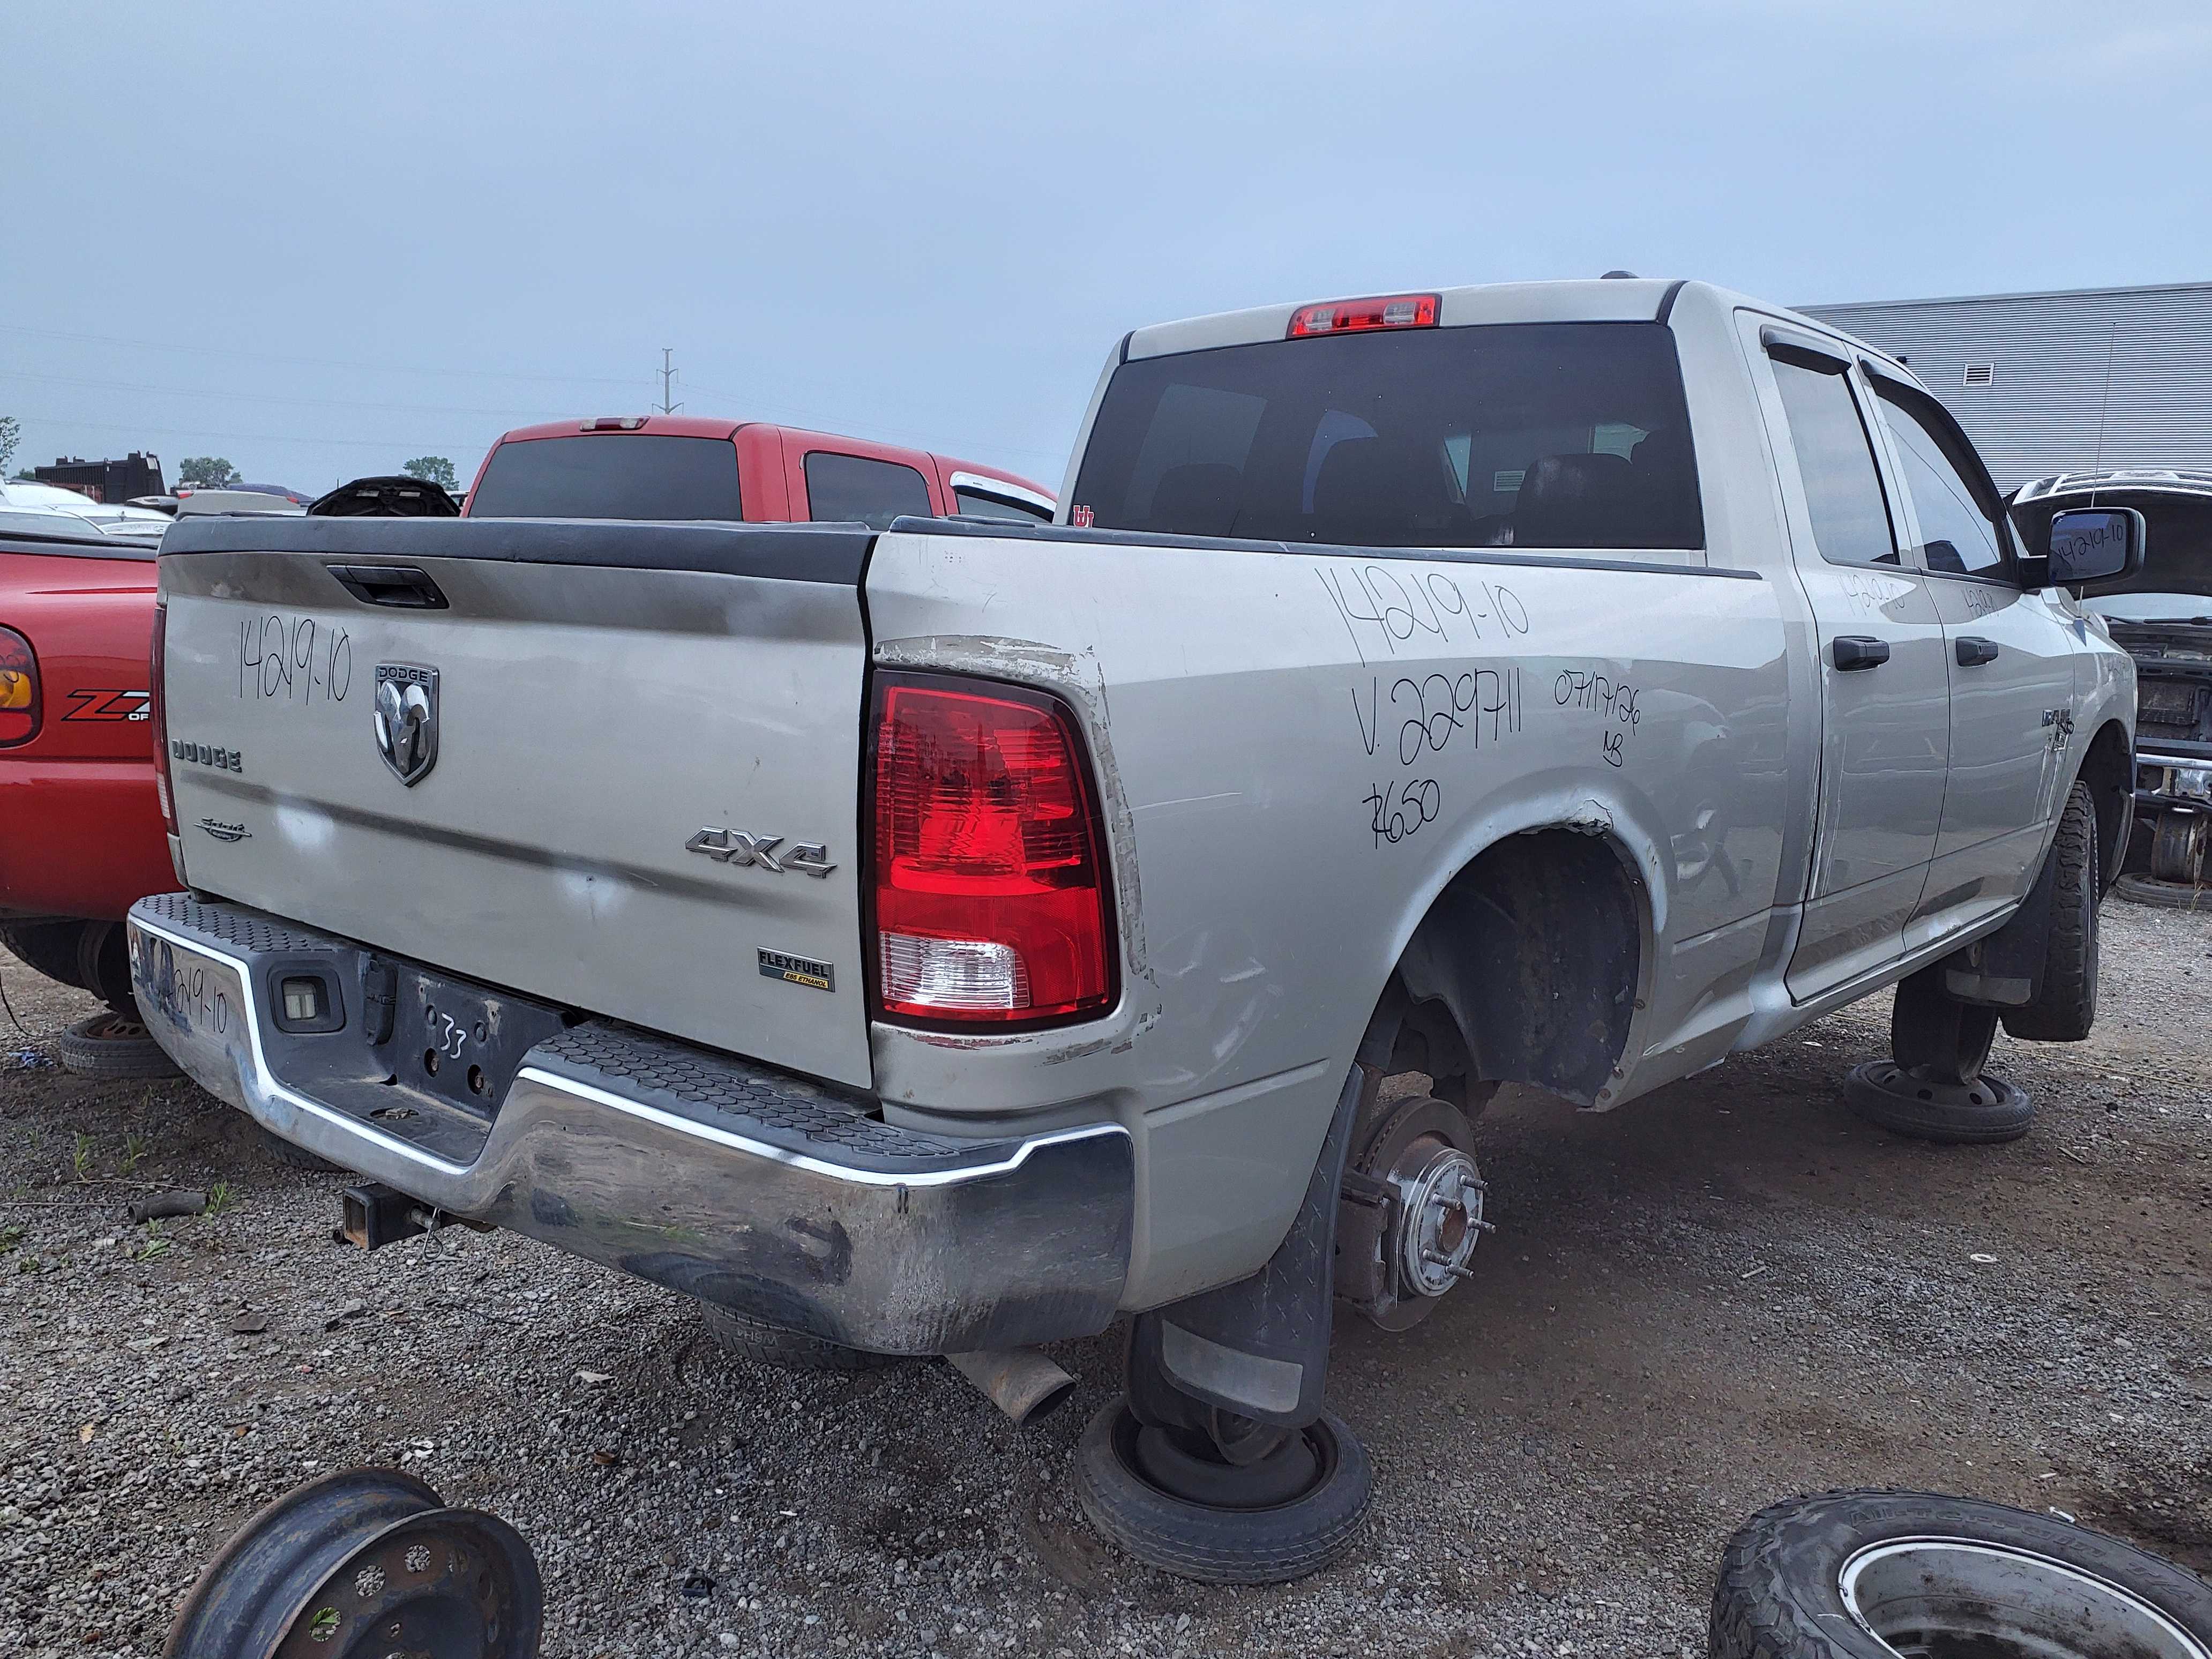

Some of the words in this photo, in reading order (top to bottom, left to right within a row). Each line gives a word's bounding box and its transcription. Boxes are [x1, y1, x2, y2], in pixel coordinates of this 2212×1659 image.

[2058, 524, 2123, 562] 14219-10
[1315, 566, 1528, 668] 14219-10
[379, 667, 428, 683] DODGE
[1392, 667, 1521, 765] 229711
[171, 738, 242, 773] DODGE
[759, 951, 828, 978] FLEXFUEL
[785, 973, 797, 981] E85
[798, 976, 826, 987] ETHANOL
[440, 1013, 467, 1059] 33
